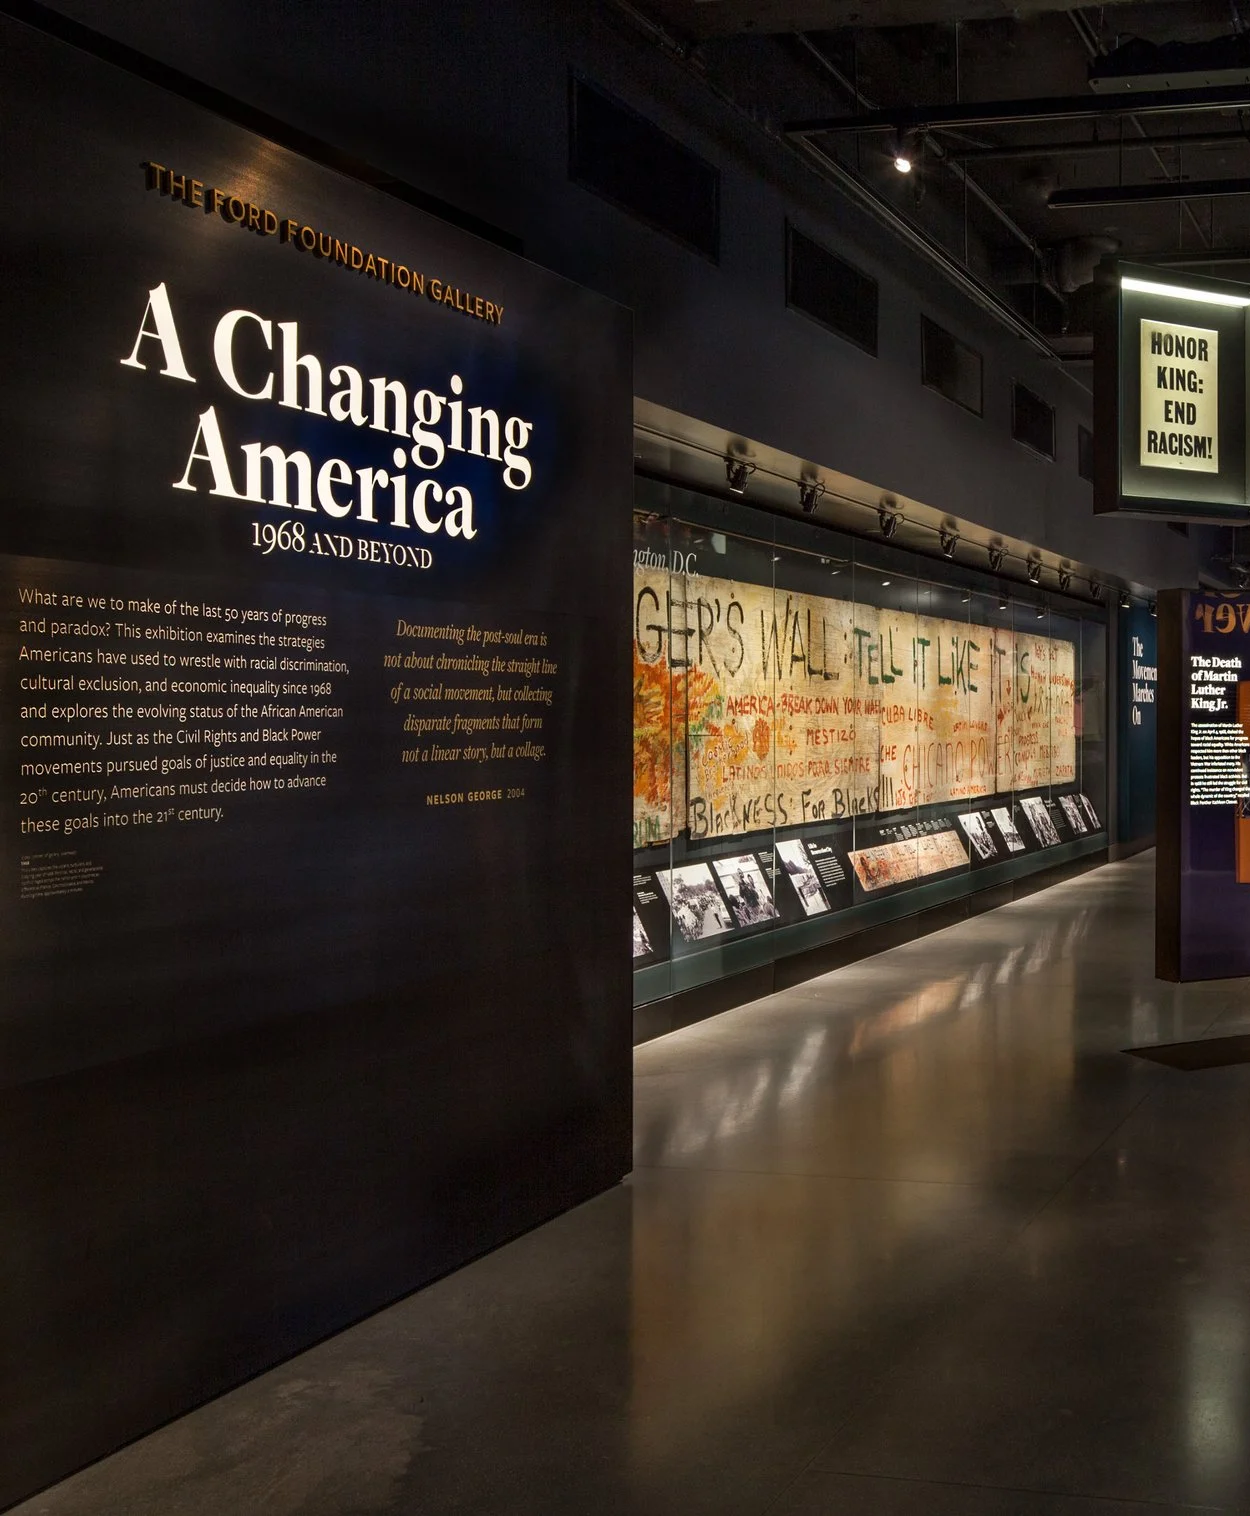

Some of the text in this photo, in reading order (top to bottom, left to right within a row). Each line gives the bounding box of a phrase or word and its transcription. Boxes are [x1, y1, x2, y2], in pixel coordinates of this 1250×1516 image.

[147, 161, 504, 325] THE FORD FOUNDATION GALLERY
[1151, 331, 1208, 362] HONOR
[120, 281, 534, 490] A Changing
[1157, 366, 1203, 394] KING:
[1164, 400, 1197, 425] END
[1147, 430, 1213, 459] RACISM!
[171, 403, 478, 540] America
[252, 520, 432, 569] 1968 AND BEYOND
[672, 550, 699, 577] D.C.
[19, 588, 327, 629] What are we to make of the last 50 years of progress
[19, 618, 325, 652] and paradox? This exhibition examines the strategies
[396, 619, 547, 647] Documenting the post-soul era is
[1132, 636, 1144, 657] The
[18, 646, 350, 675] Americans have used to wrestle with racial discrimination,
[383, 651, 558, 678] not about chronicling the straight line
[854, 627, 904, 685] TELL
[1190, 656, 1242, 668] The Death
[20, 674, 332, 697] cultural exclusion, and economic inequality since 1968
[1190, 684, 1226, 695] Luther
[1191, 670, 1238, 682] of Martin
[1132, 683, 1155, 703] Marches
[1190, 698, 1228, 711] King Jr.
[908, 707, 934, 731] LIBRE
[1132, 705, 1142, 725] On
[426, 788, 525, 806] NELSON GEORGE 2004
